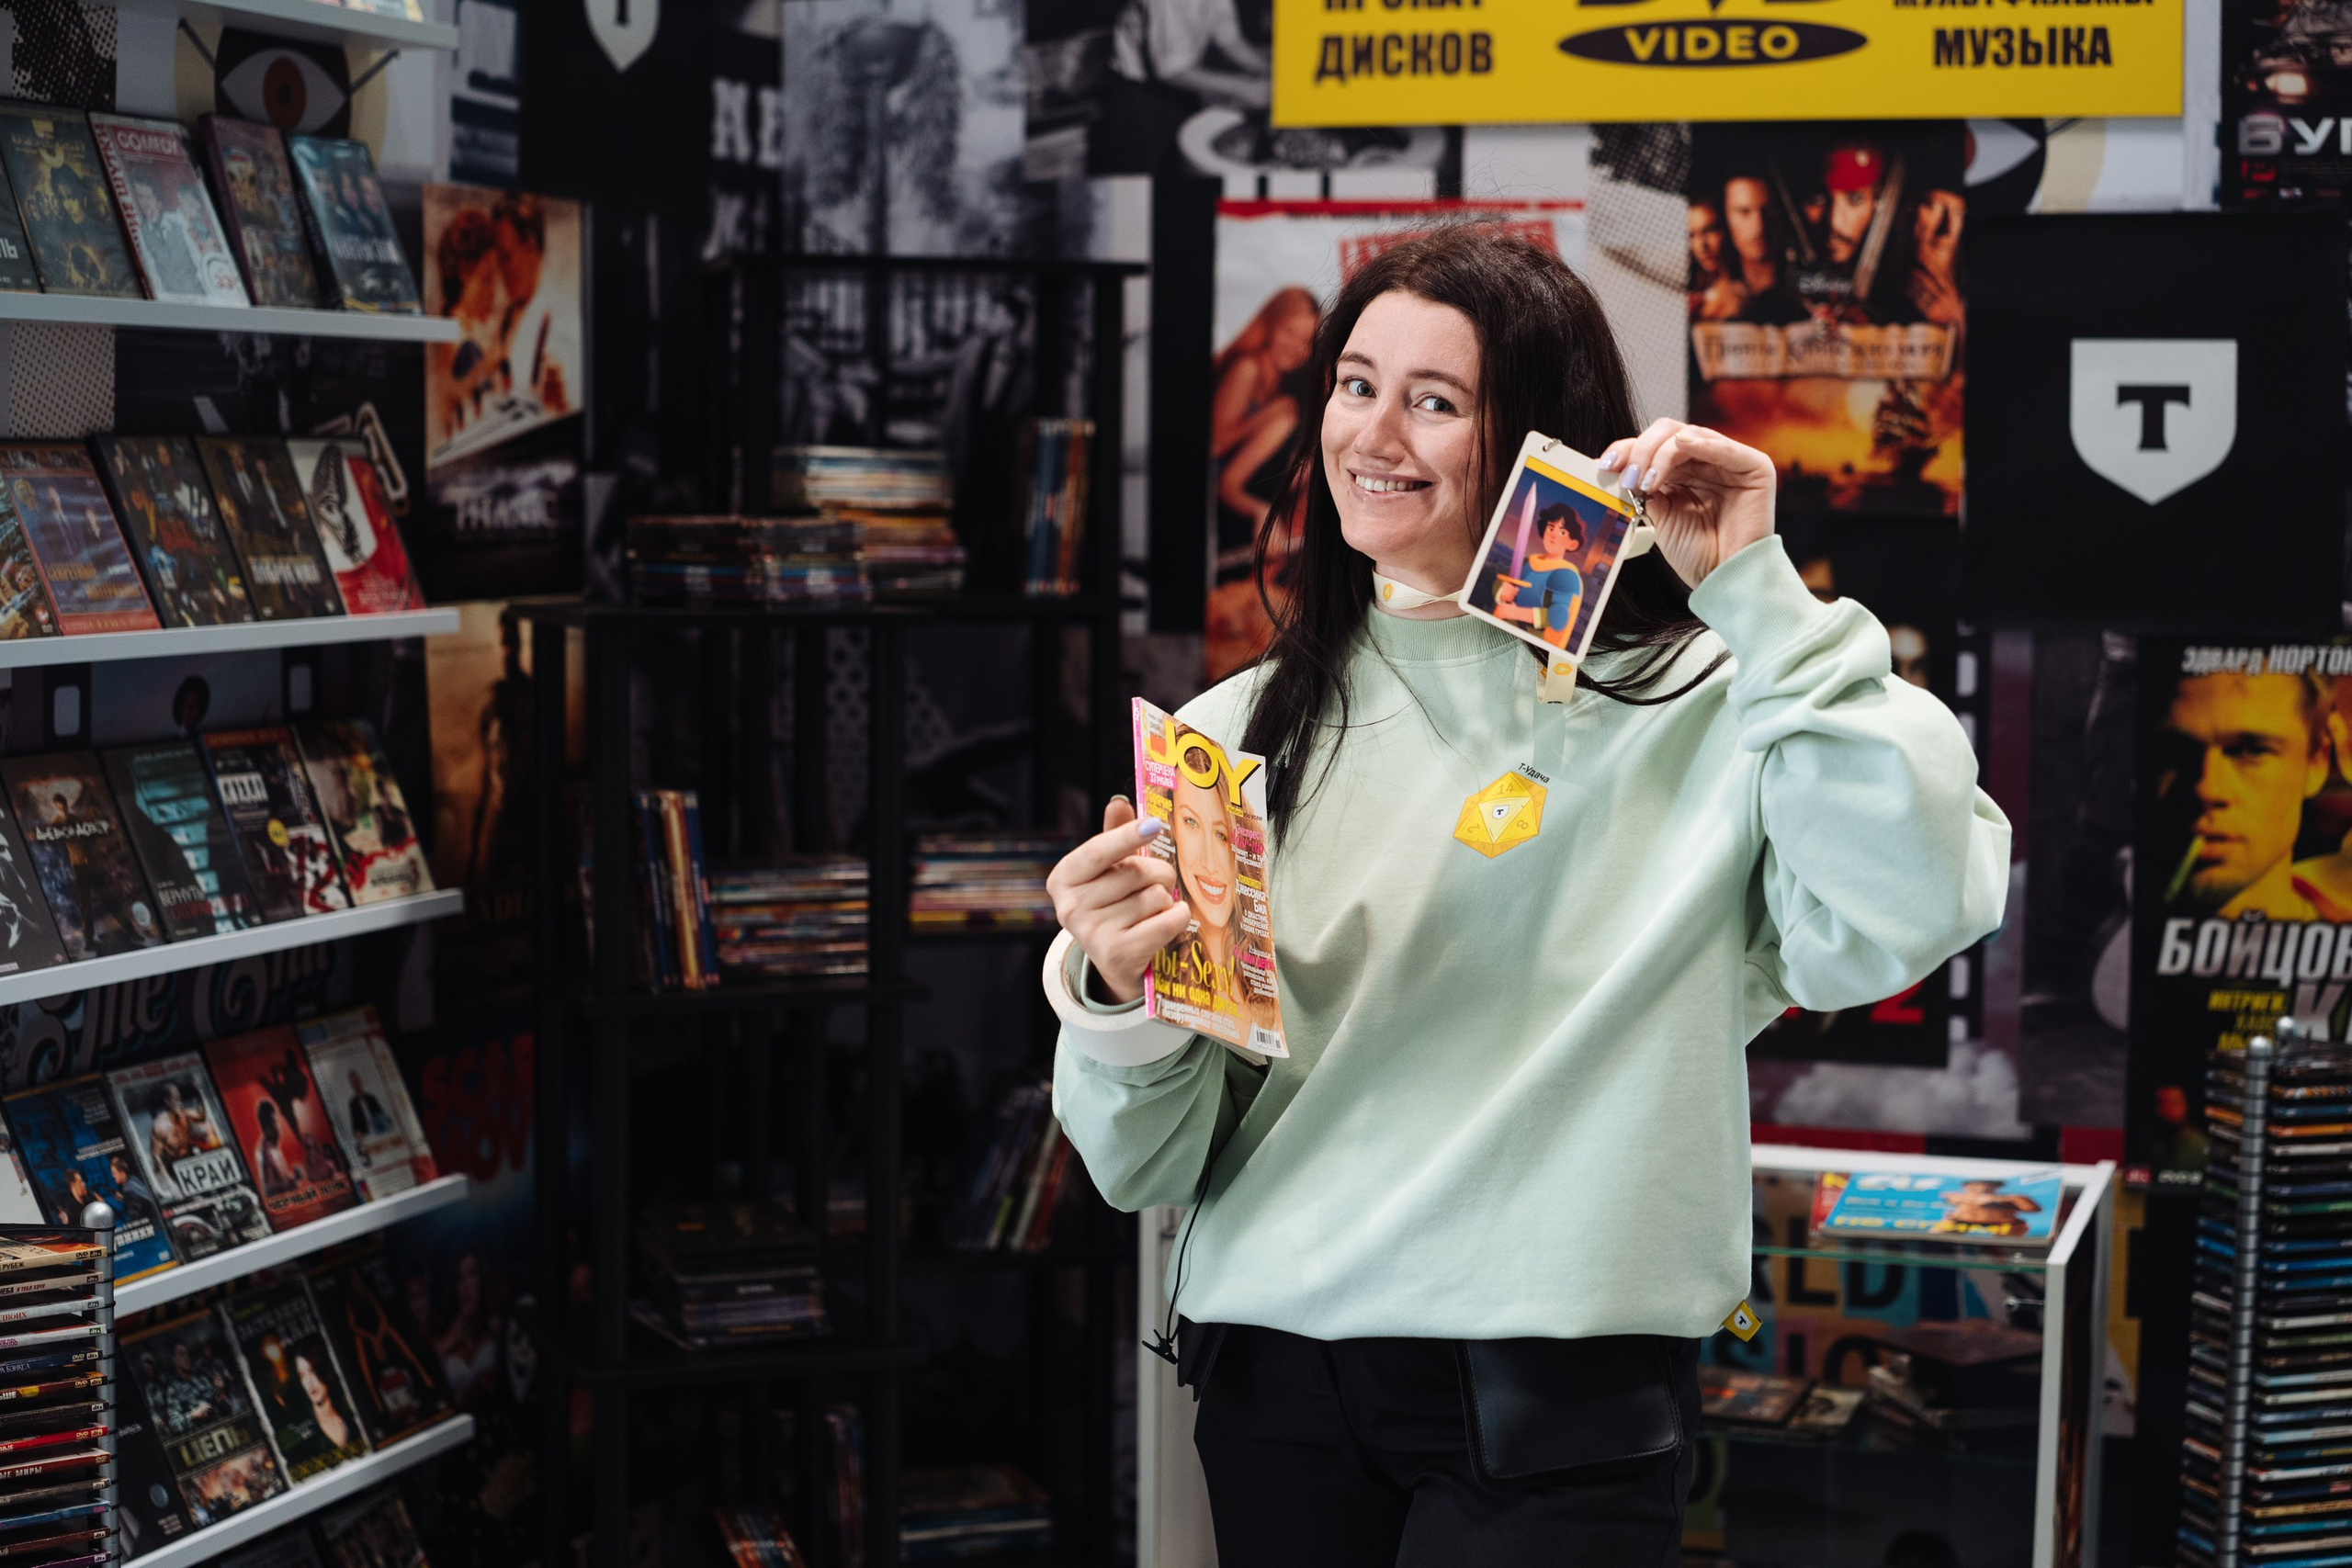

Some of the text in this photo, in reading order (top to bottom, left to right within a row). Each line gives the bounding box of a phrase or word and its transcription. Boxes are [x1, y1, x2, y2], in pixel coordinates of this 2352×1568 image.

[1623, 25, 1799, 61] VIDEO
[1933, 25, 2112, 67] МУЗЫКА
[1314, 32, 1494, 85] ДИСКОВ
[1143, 719, 1262, 807] JOY
[1518, 762, 1550, 784] Т-Удача
[1254, 899, 1267, 915] Бил
[1191, 940, 1235, 998] Sexy!
[1155, 973, 1170, 995] Как
[1172, 983, 1186, 998] ни
[1189, 987, 1211, 1008] одна
[75, 1251, 89, 1259] DVD
[2, 1261, 25, 1270] РУБЕЖ
[73, 1353, 85, 1362] DVD
[74, 1380, 88, 1388] DVD
[76, 1431, 89, 1439] DVD
[16, 1467, 42, 1477] МИРЫ
